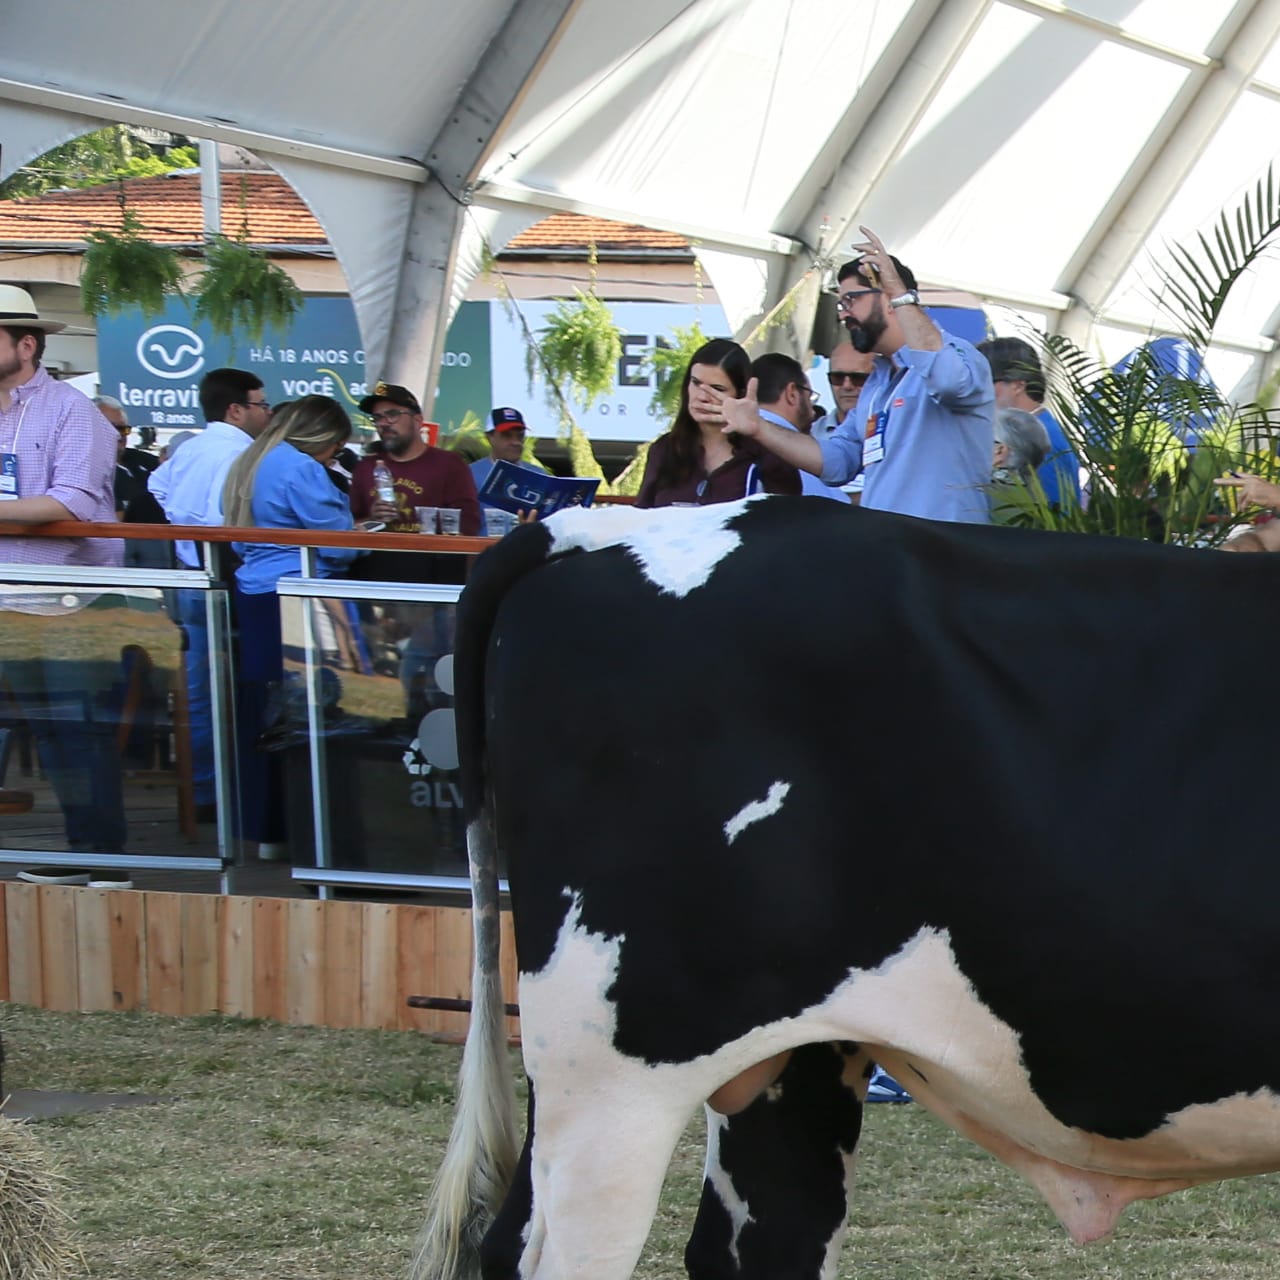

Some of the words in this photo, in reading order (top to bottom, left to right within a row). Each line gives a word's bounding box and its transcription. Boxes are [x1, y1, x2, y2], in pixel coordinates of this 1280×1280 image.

[279, 349, 297, 363] 18
[301, 349, 349, 365] ANOS
[119, 382, 200, 408] terravi
[282, 376, 335, 397] VOCÊ
[151, 411, 165, 424] 18
[166, 413, 196, 425] anos
